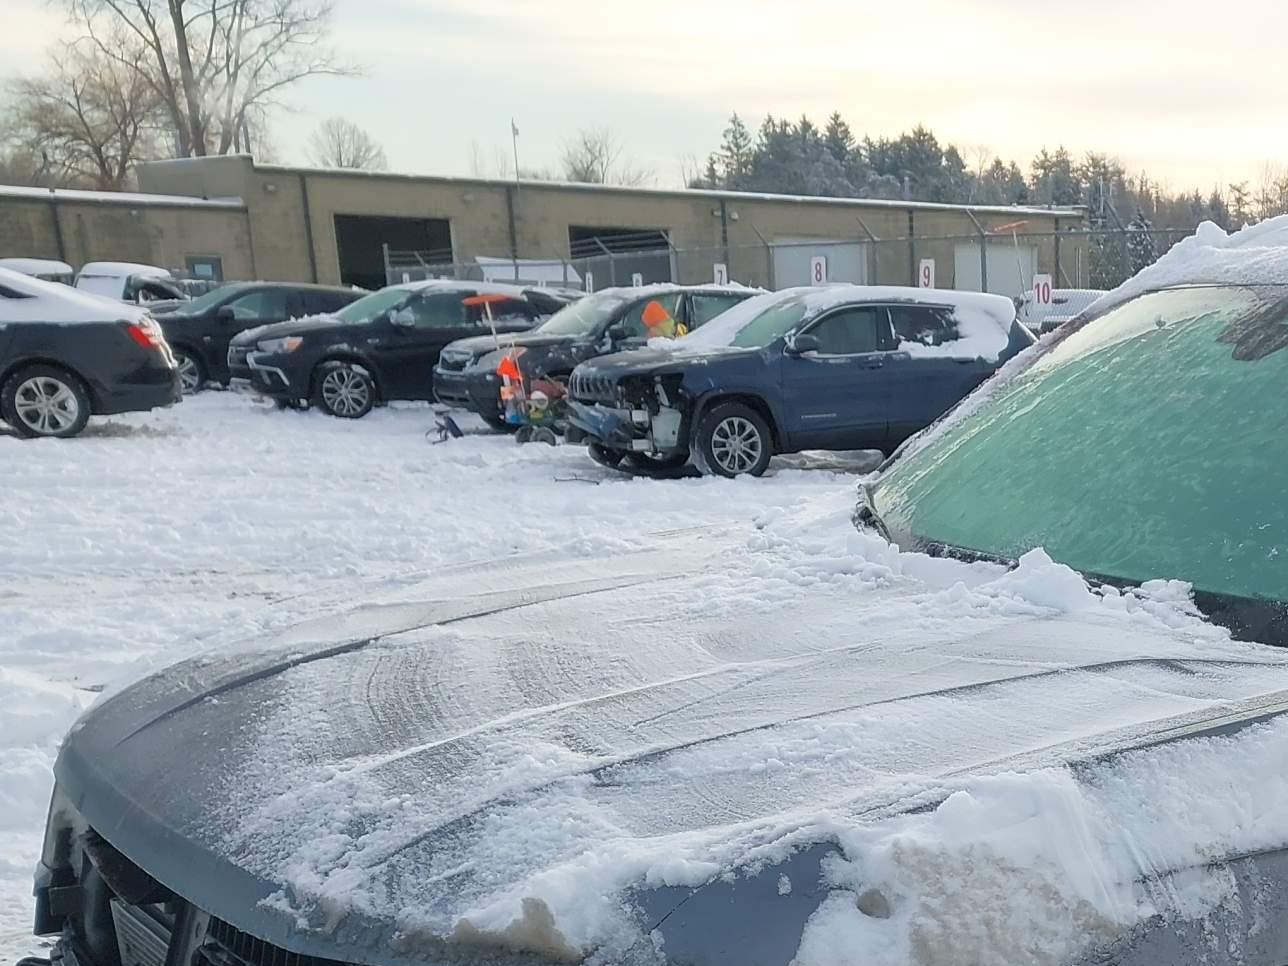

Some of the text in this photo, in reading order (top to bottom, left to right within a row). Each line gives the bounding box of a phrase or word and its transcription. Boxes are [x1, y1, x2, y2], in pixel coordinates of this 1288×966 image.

[814, 262, 822, 282] 8
[922, 265, 931, 287] 9
[1034, 283, 1050, 304] 10
